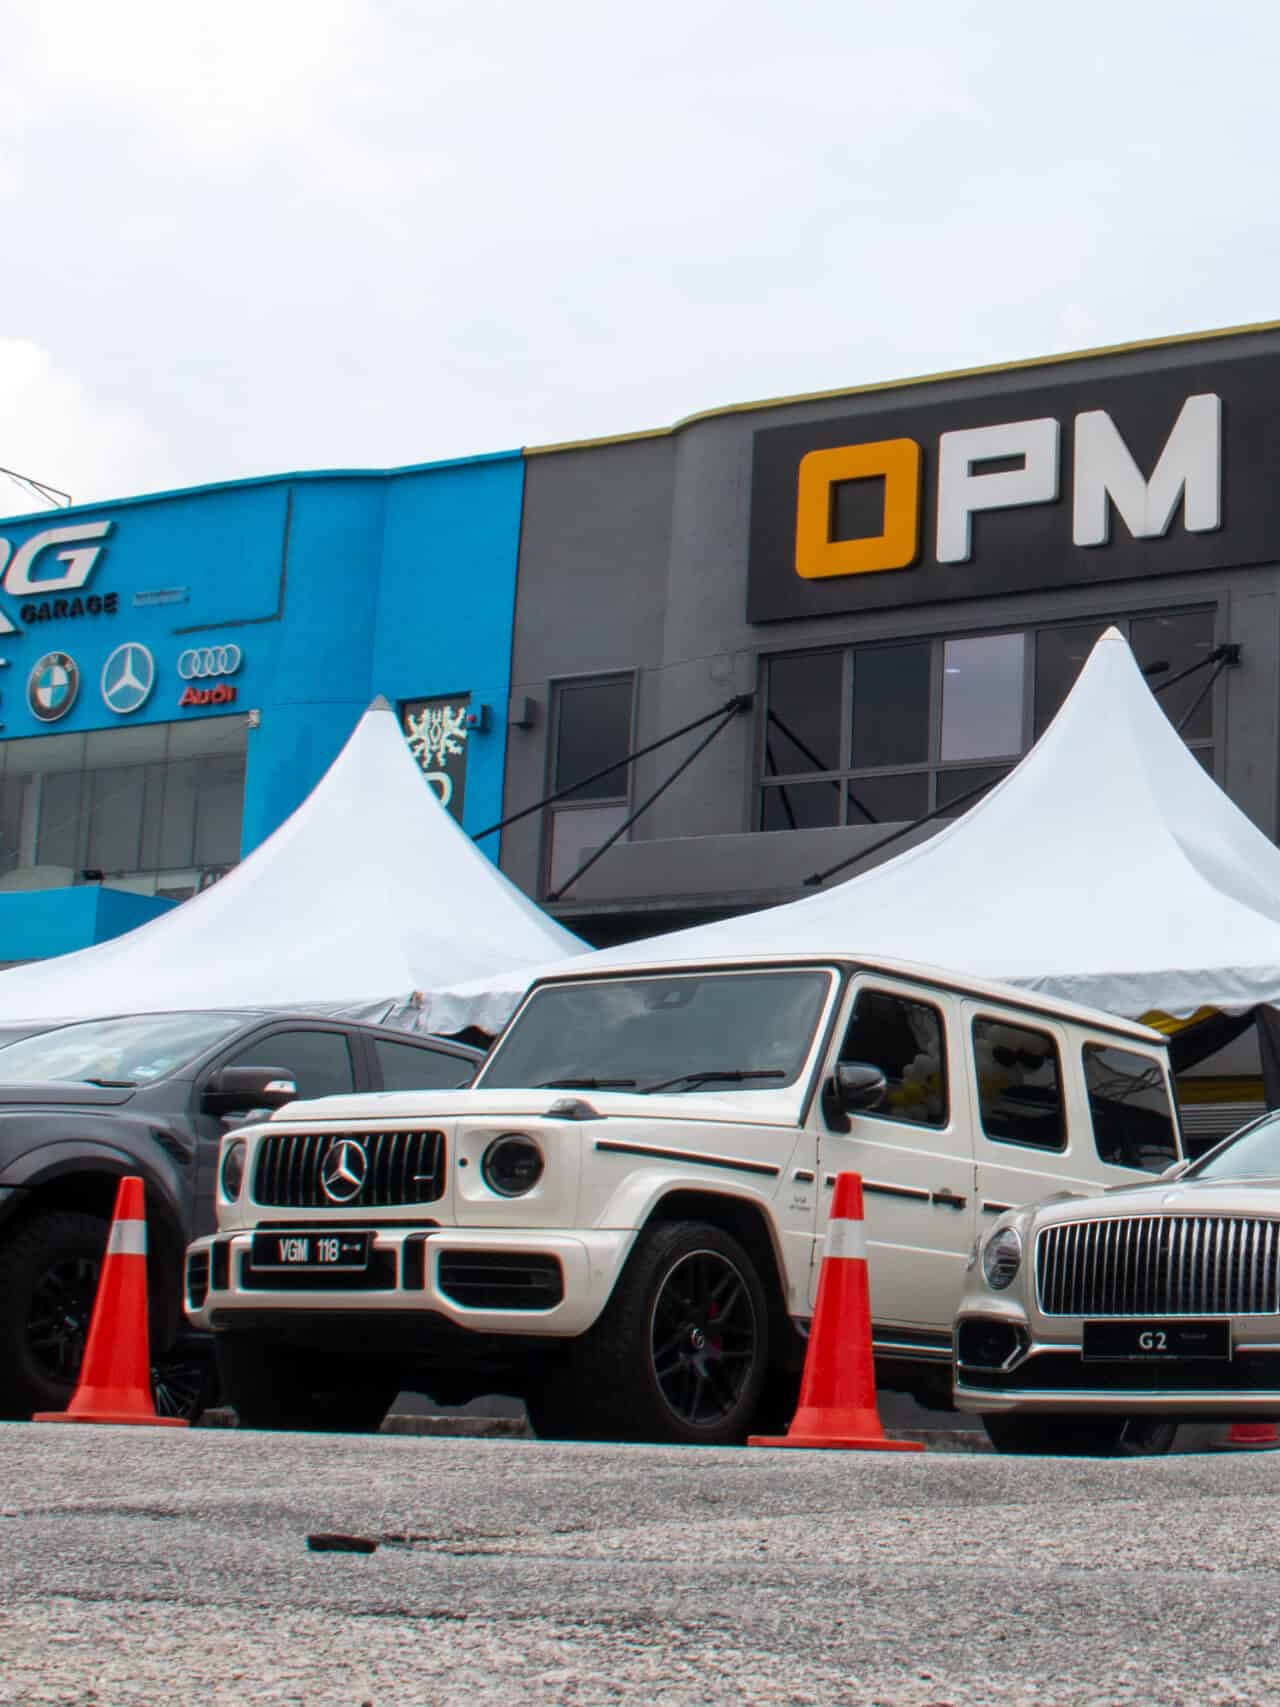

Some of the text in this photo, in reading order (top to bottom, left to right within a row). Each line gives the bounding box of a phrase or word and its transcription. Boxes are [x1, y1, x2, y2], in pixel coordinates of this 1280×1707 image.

[795, 392, 1222, 579] OPM
[20, 592, 119, 624] GARAGE
[177, 683, 238, 707] Audi
[279, 1238, 340, 1262] VGM 118
[1138, 1331, 1168, 1350] G2
